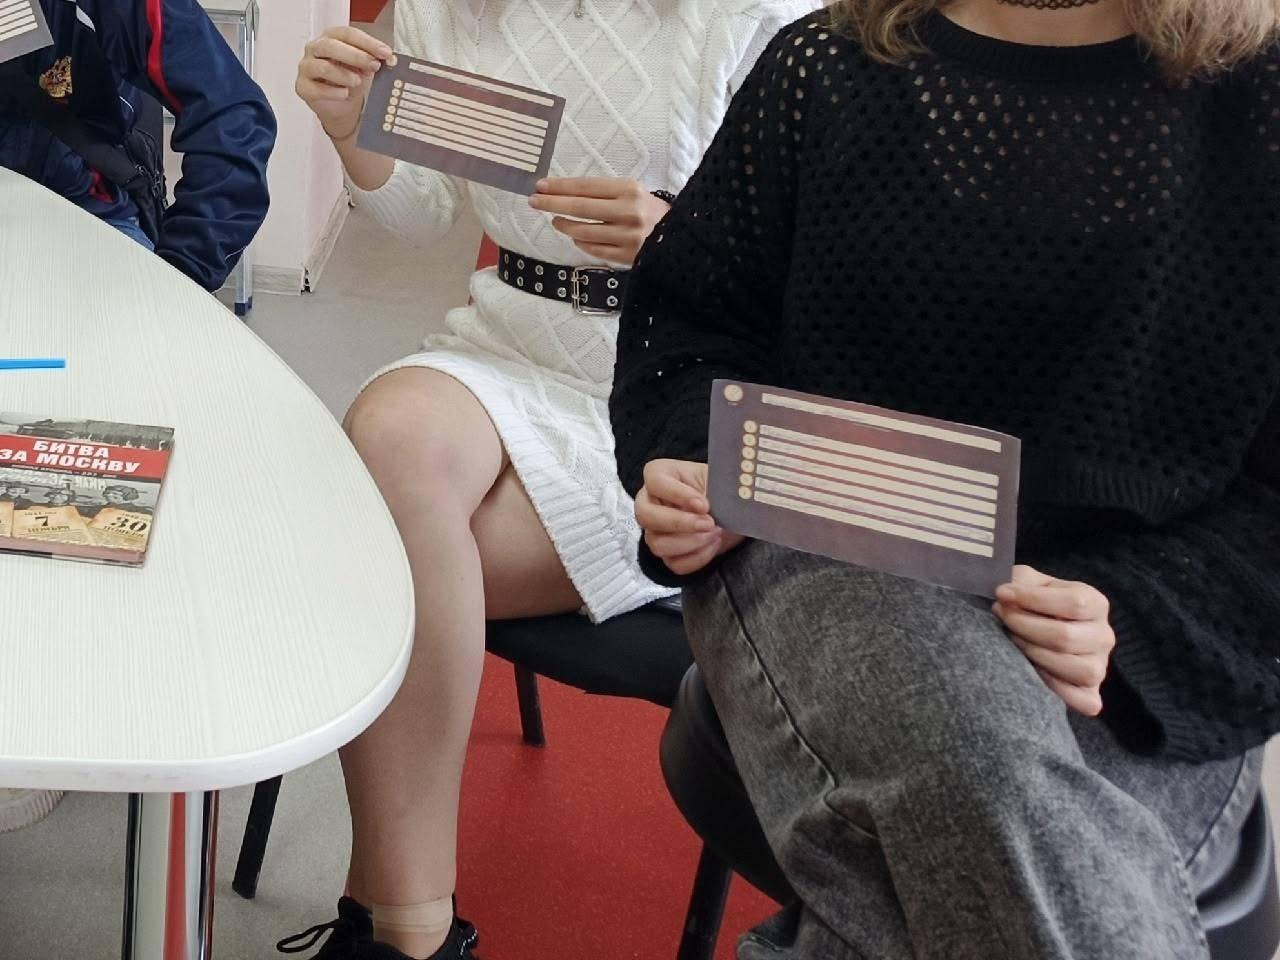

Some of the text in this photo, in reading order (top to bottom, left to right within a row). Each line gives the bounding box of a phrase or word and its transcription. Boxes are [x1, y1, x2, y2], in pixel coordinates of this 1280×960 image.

[32, 440, 110, 458] БИТВА
[35, 453, 141, 474] МОСКВУ
[33, 515, 50, 528] 7
